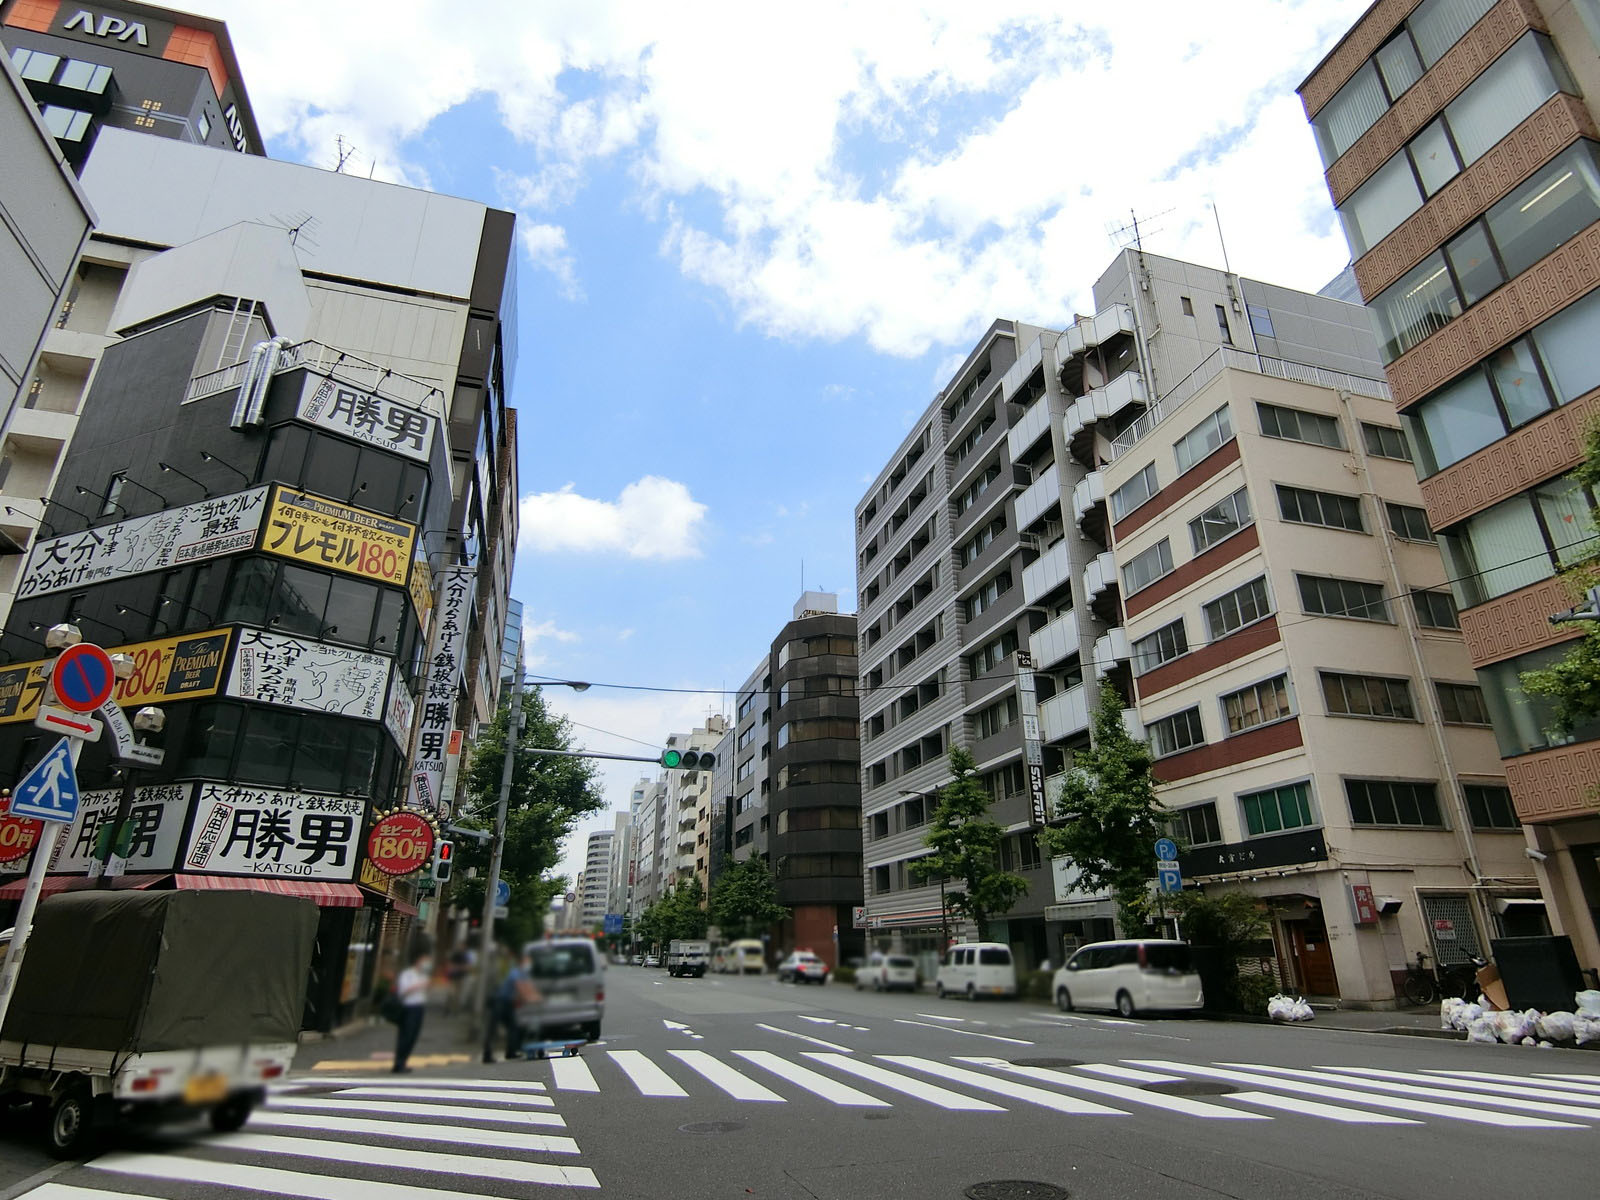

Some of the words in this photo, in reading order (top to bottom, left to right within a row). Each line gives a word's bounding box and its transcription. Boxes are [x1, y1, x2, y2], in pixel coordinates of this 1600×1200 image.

[64, 10, 149, 46] APA
[225, 102, 248, 154] APA
[327, 388, 429, 451] 勝男
[190, 490, 265, 523] ご当地グルメ
[313, 501, 351, 520] PREMIUM
[353, 513, 379, 528] BEER
[101, 524, 124, 557] 中津
[154, 507, 193, 567] からあげの聖地
[201, 514, 241, 539] 最強
[270, 519, 359, 567] プレモル
[35, 530, 105, 571] 大分
[356, 540, 397, 579] 180
[20, 560, 92, 596] からあげ
[241, 631, 308, 658] 大分
[256, 651, 297, 668] 中津
[173, 650, 220, 673] PREMIUM
[184, 670, 201, 679] BEER
[179, 680, 201, 689] DRAFT
[256, 664, 288, 702] からあげ
[420, 702, 451, 760] 勝男
[414, 761, 444, 773] KATSUO
[201, 785, 363, 817] 大分からあげと鉄板焼
[191, 805, 229, 865] 神田応援団
[219, 808, 353, 867] 勝男
[380, 824, 424, 838] 生ビール
[1160, 844, 1169, 861] P
[1164, 872, 1178, 891] P
